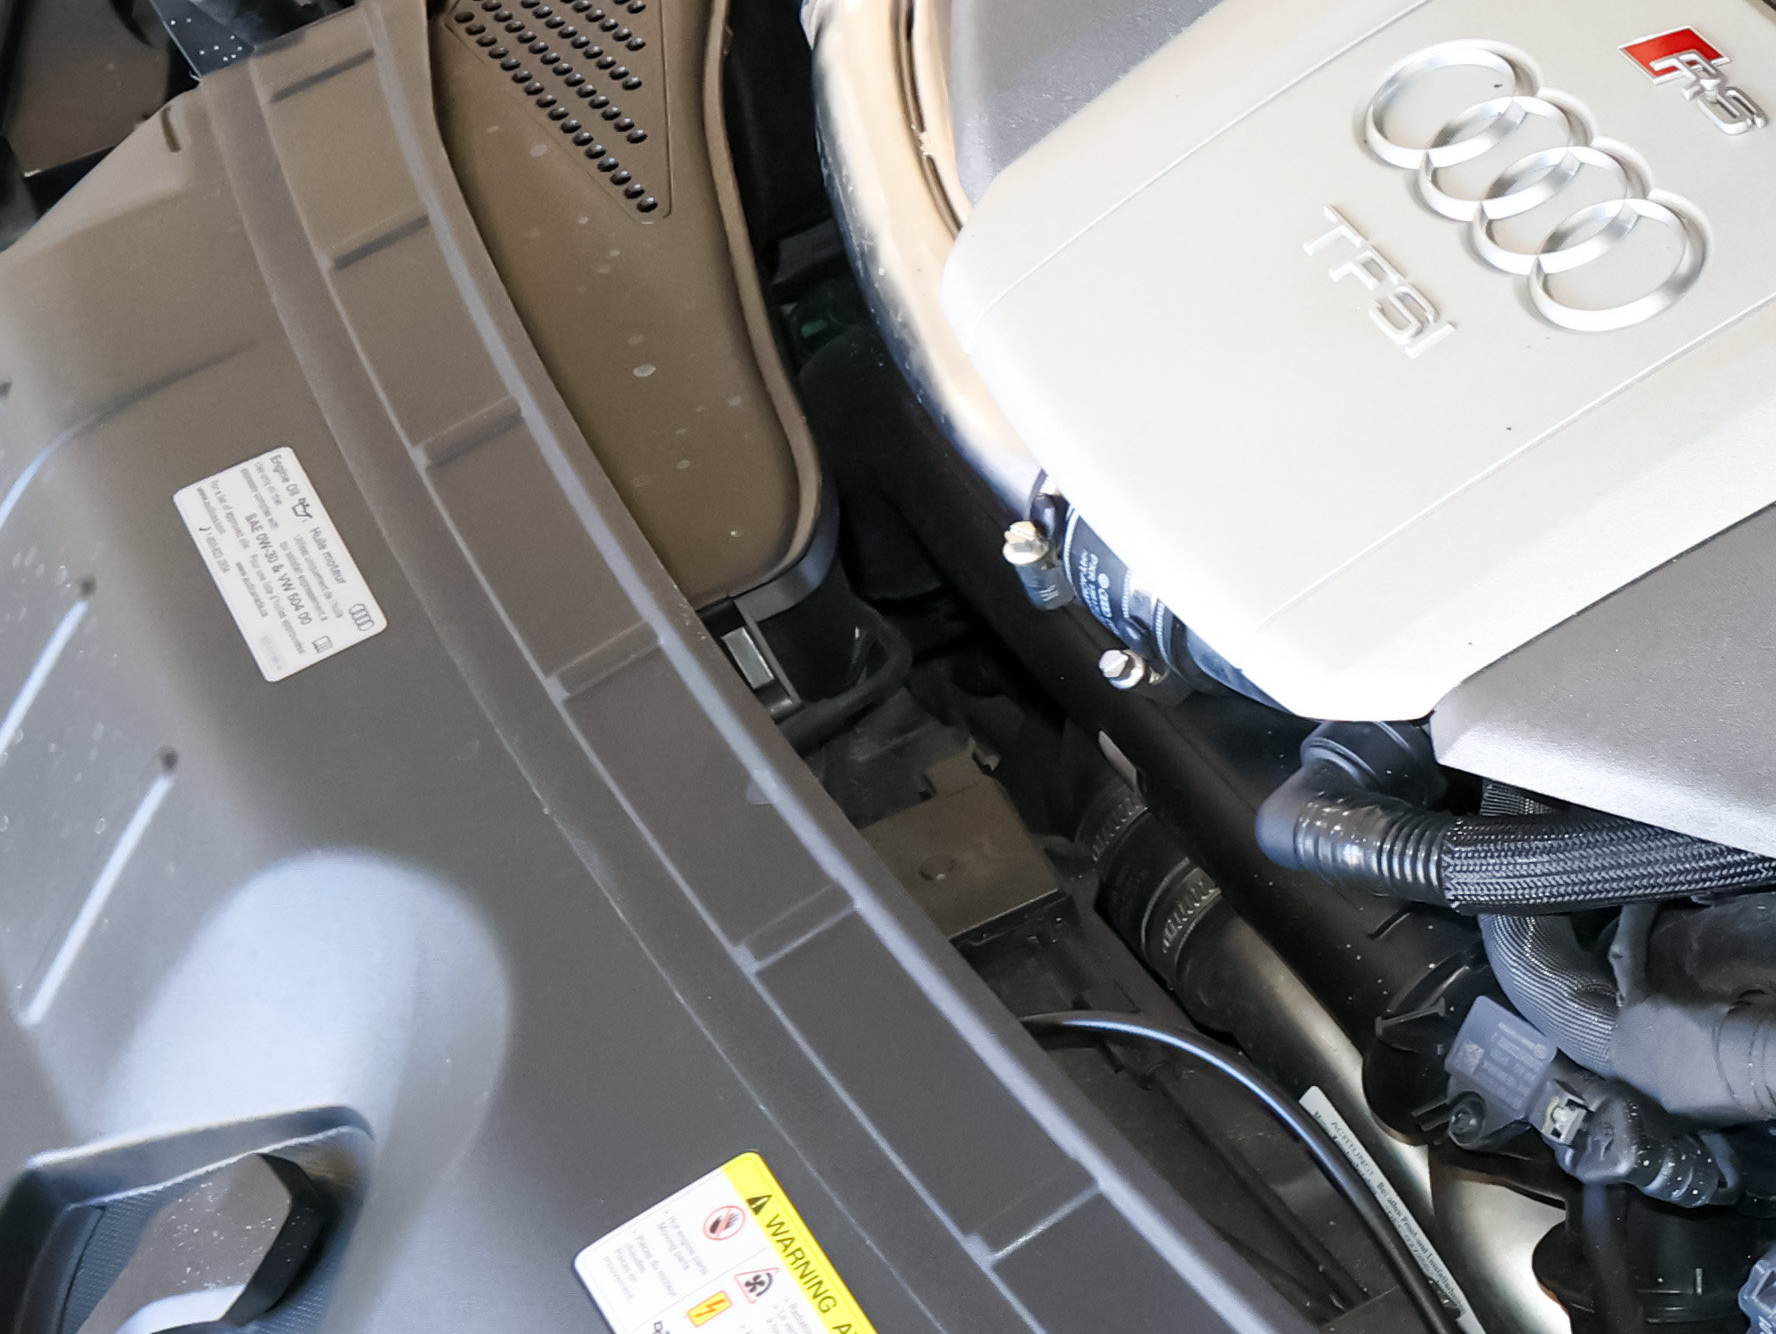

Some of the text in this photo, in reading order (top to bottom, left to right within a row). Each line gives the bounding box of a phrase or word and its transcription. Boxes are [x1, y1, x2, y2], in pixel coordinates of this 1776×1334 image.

[1301, 202, 1458, 360] TFSI
[266, 453, 301, 497] Engine Oil
[243, 512, 264, 534] SAE
[254, 531, 280, 564] 0W-30
[308, 526, 348, 586] Huile moteur
[270, 562, 285, 574] &
[275, 572, 295, 593] VW
[296, 610, 313, 626] 00
[761, 1213, 841, 1315] WARNING
